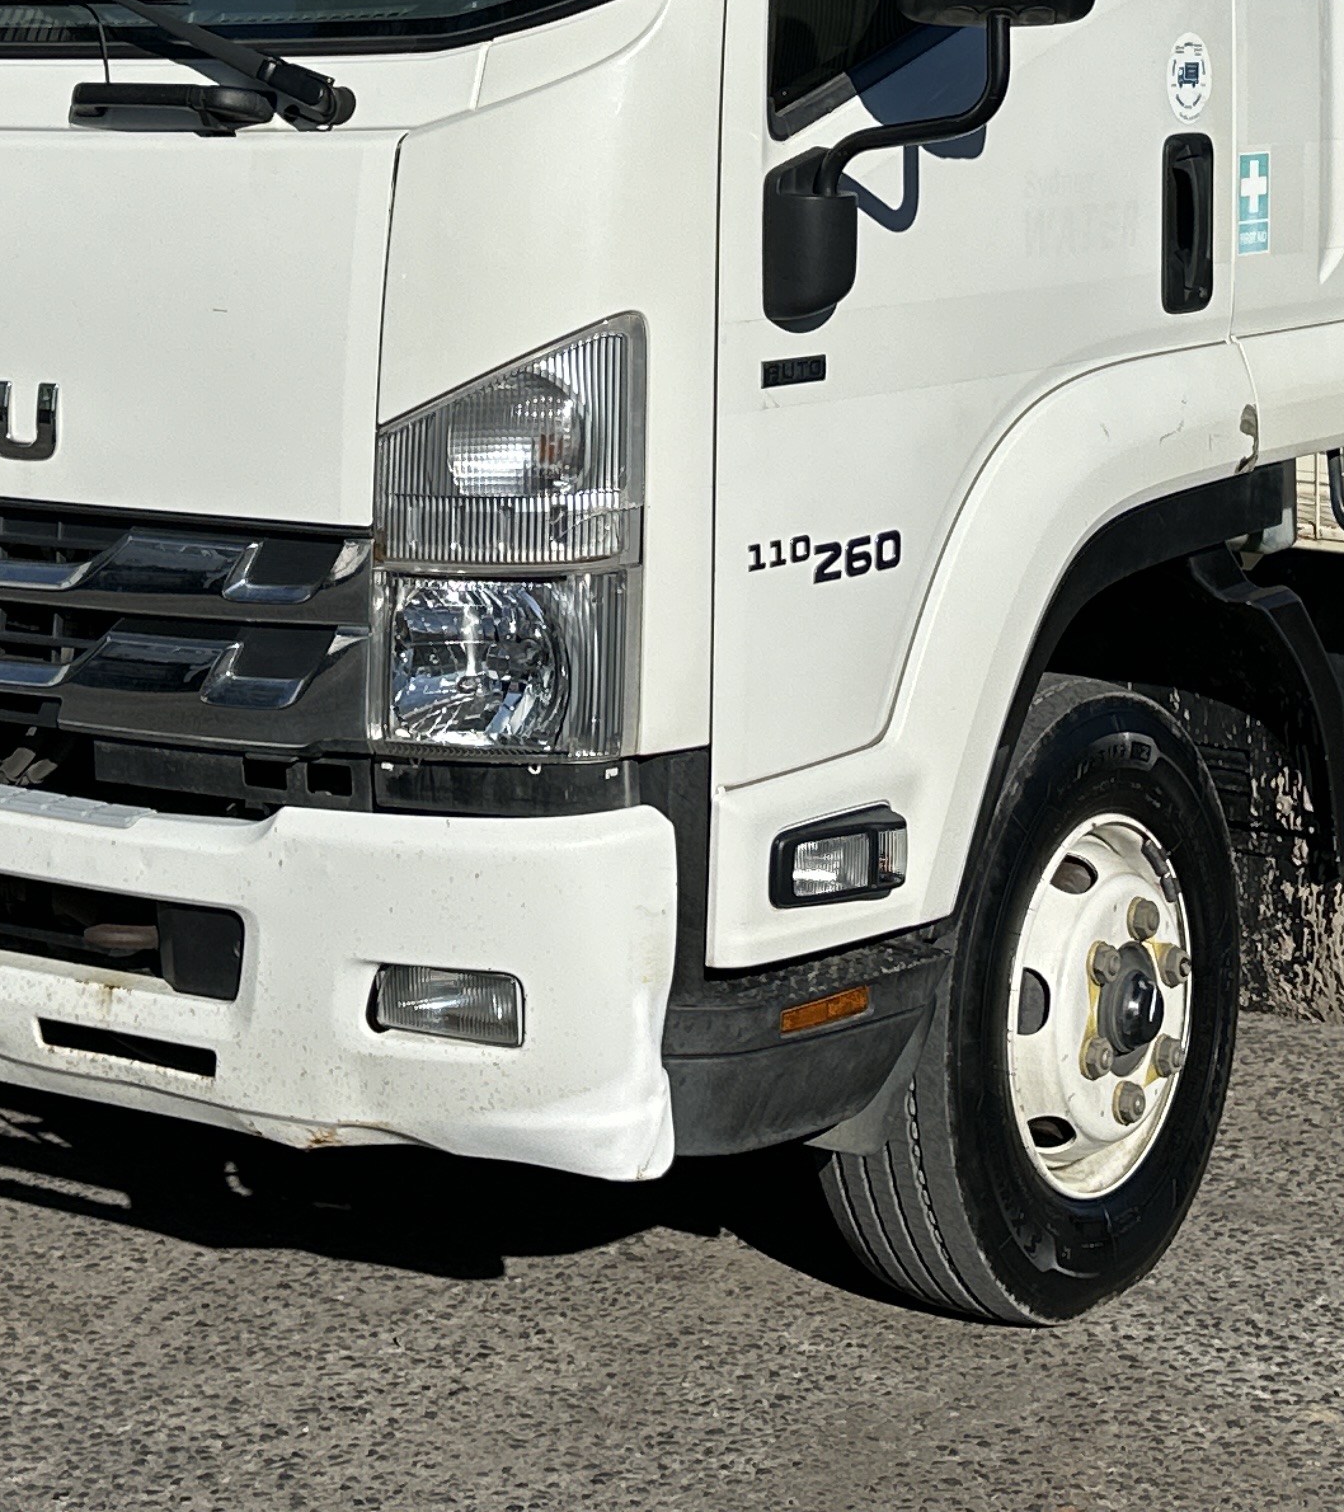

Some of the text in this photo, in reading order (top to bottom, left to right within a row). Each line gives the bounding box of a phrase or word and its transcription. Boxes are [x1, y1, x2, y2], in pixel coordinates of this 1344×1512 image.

[765, 357, 823, 386] AUTO
[746, 529, 902, 584] 110 260
